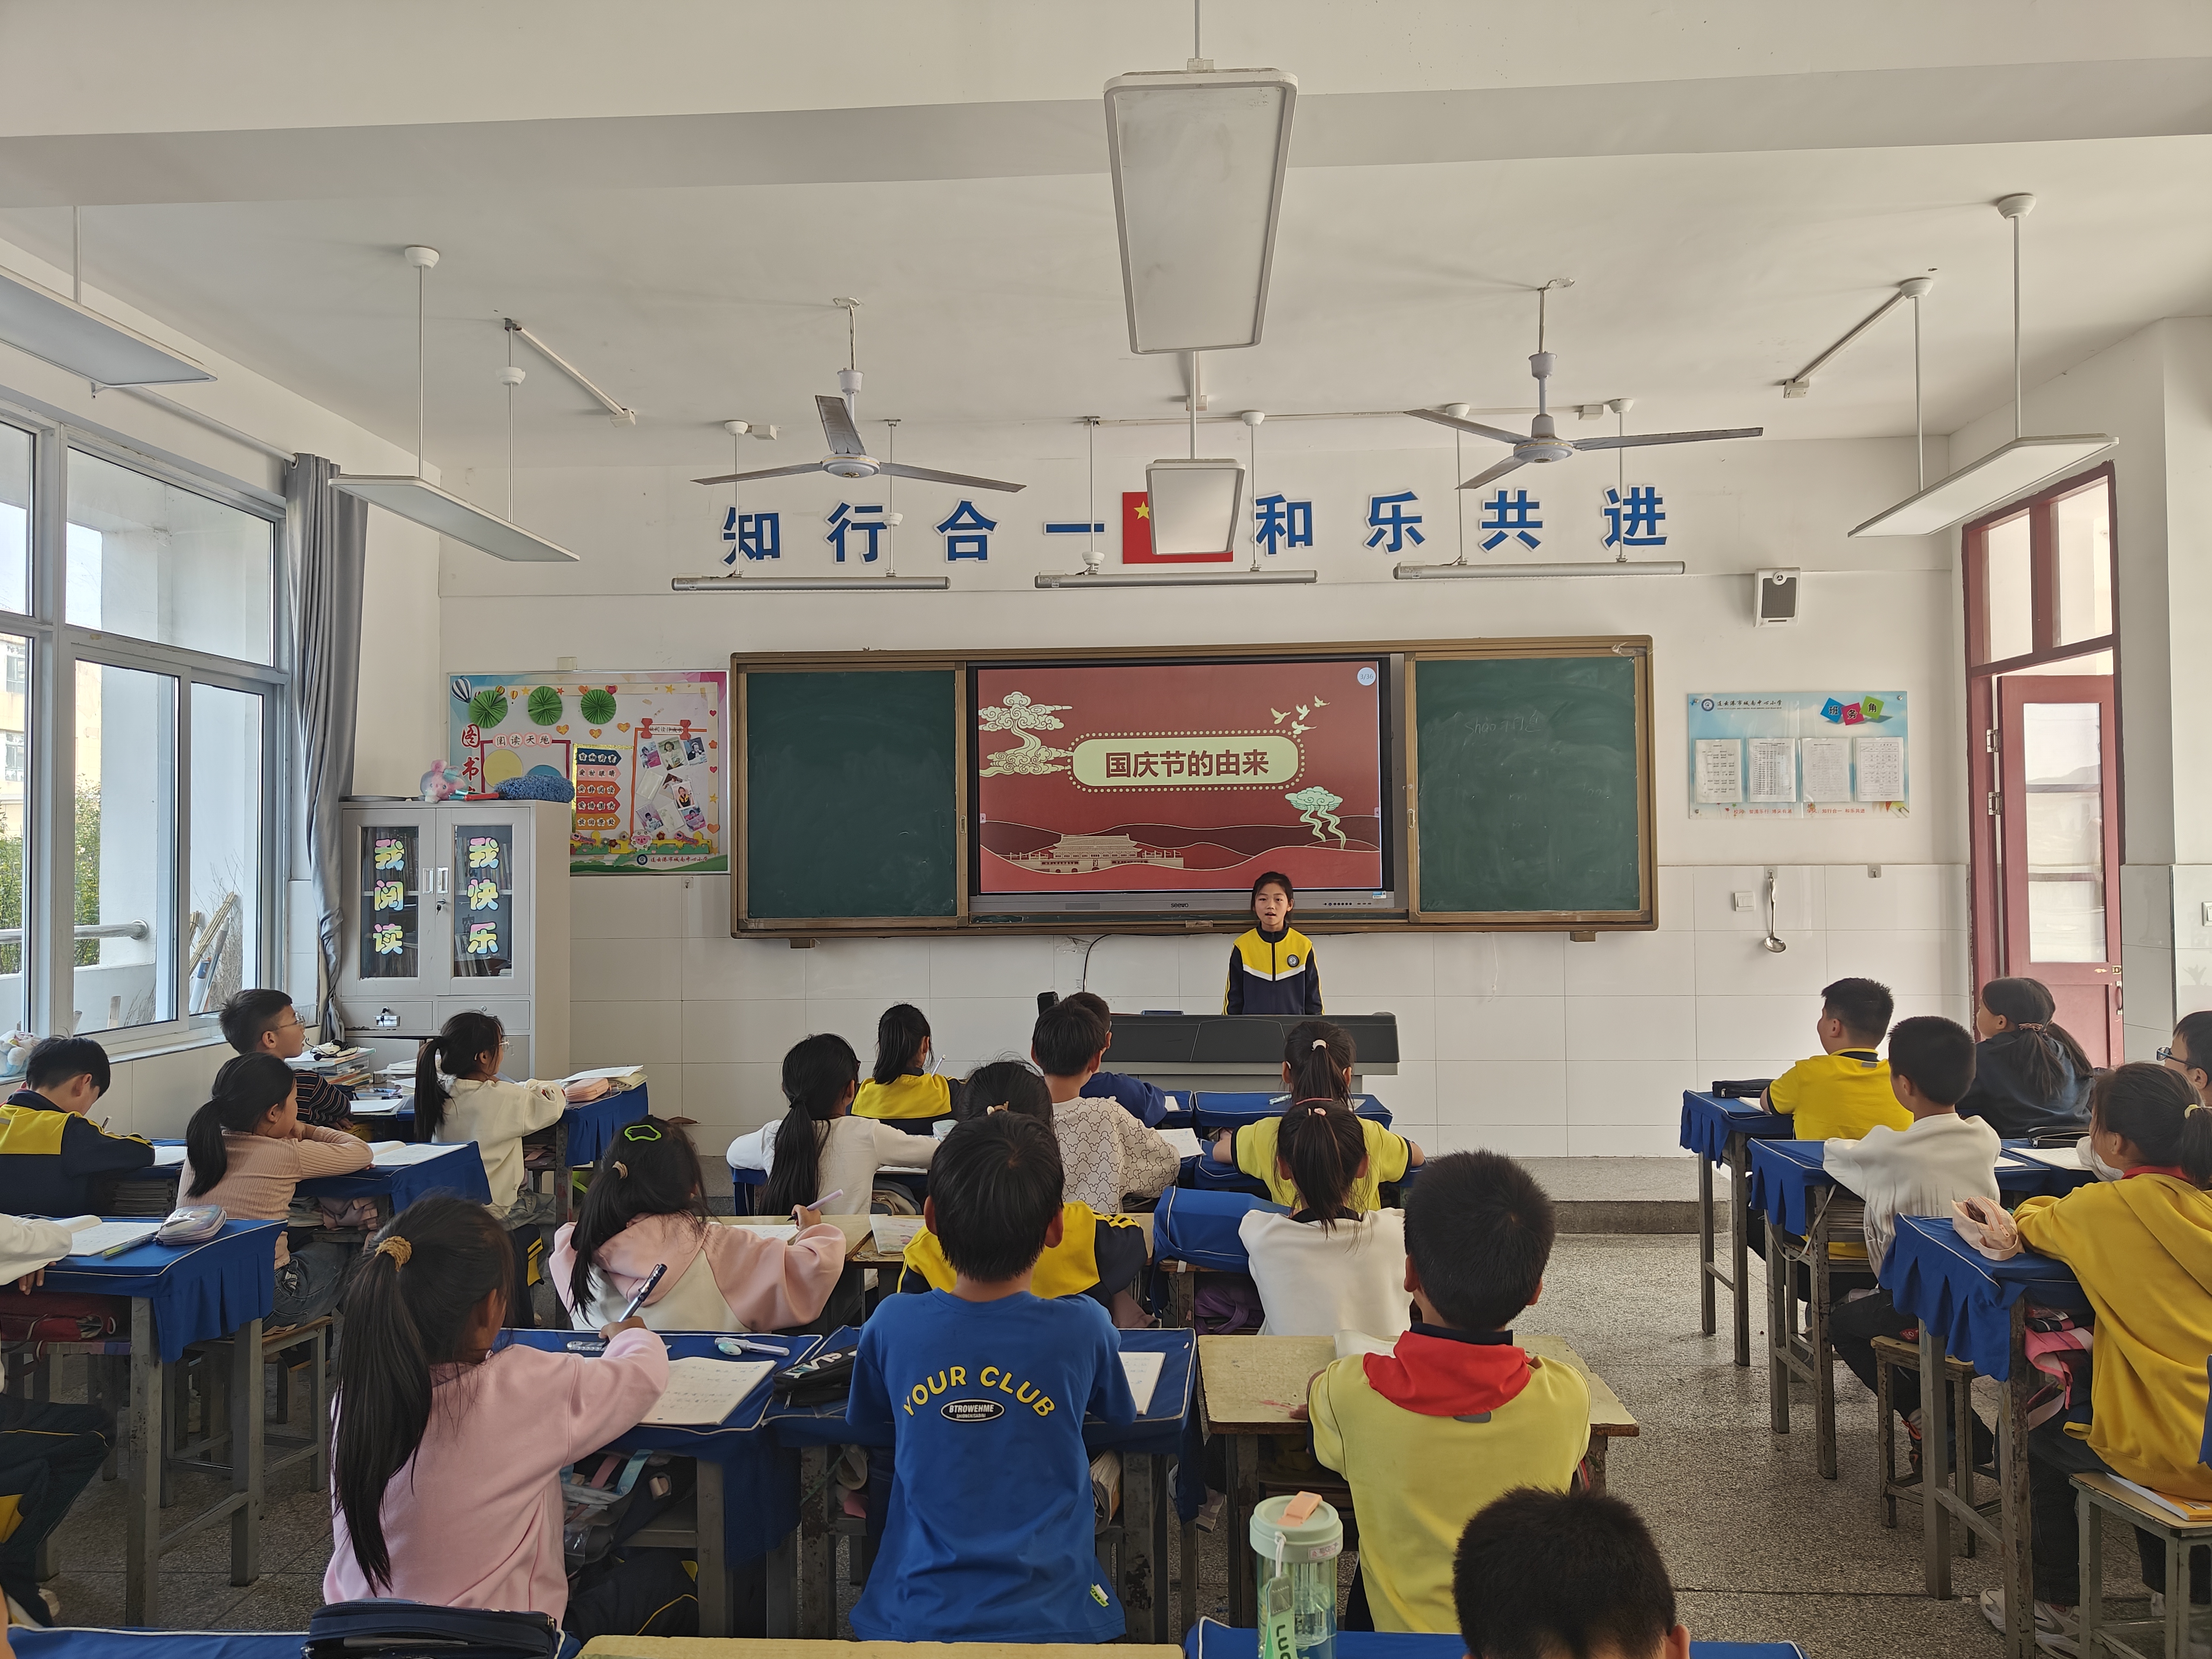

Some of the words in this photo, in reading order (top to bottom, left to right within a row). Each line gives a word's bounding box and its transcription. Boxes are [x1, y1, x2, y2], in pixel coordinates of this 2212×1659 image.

[723, 500, 1105, 564] 知行合一
[1256, 487, 1668, 555] 和乐共进
[1828, 702, 1878, 720] 班务角
[497, 735, 550, 746] 阅读天地
[462, 724, 481, 792] 图书
[579, 769, 616, 777] 爱护眼睛
[1105, 749, 1269, 779] 国庆节的由来
[578, 785, 615, 793] 安静阅读
[578, 801, 615, 810] 爱惜图书
[373, 838, 405, 955] 我阅读
[467, 837, 500, 954] 我快乐
[903, 1366, 967, 1416] YOUR
[980, 1366, 1056, 1417] CLUB
